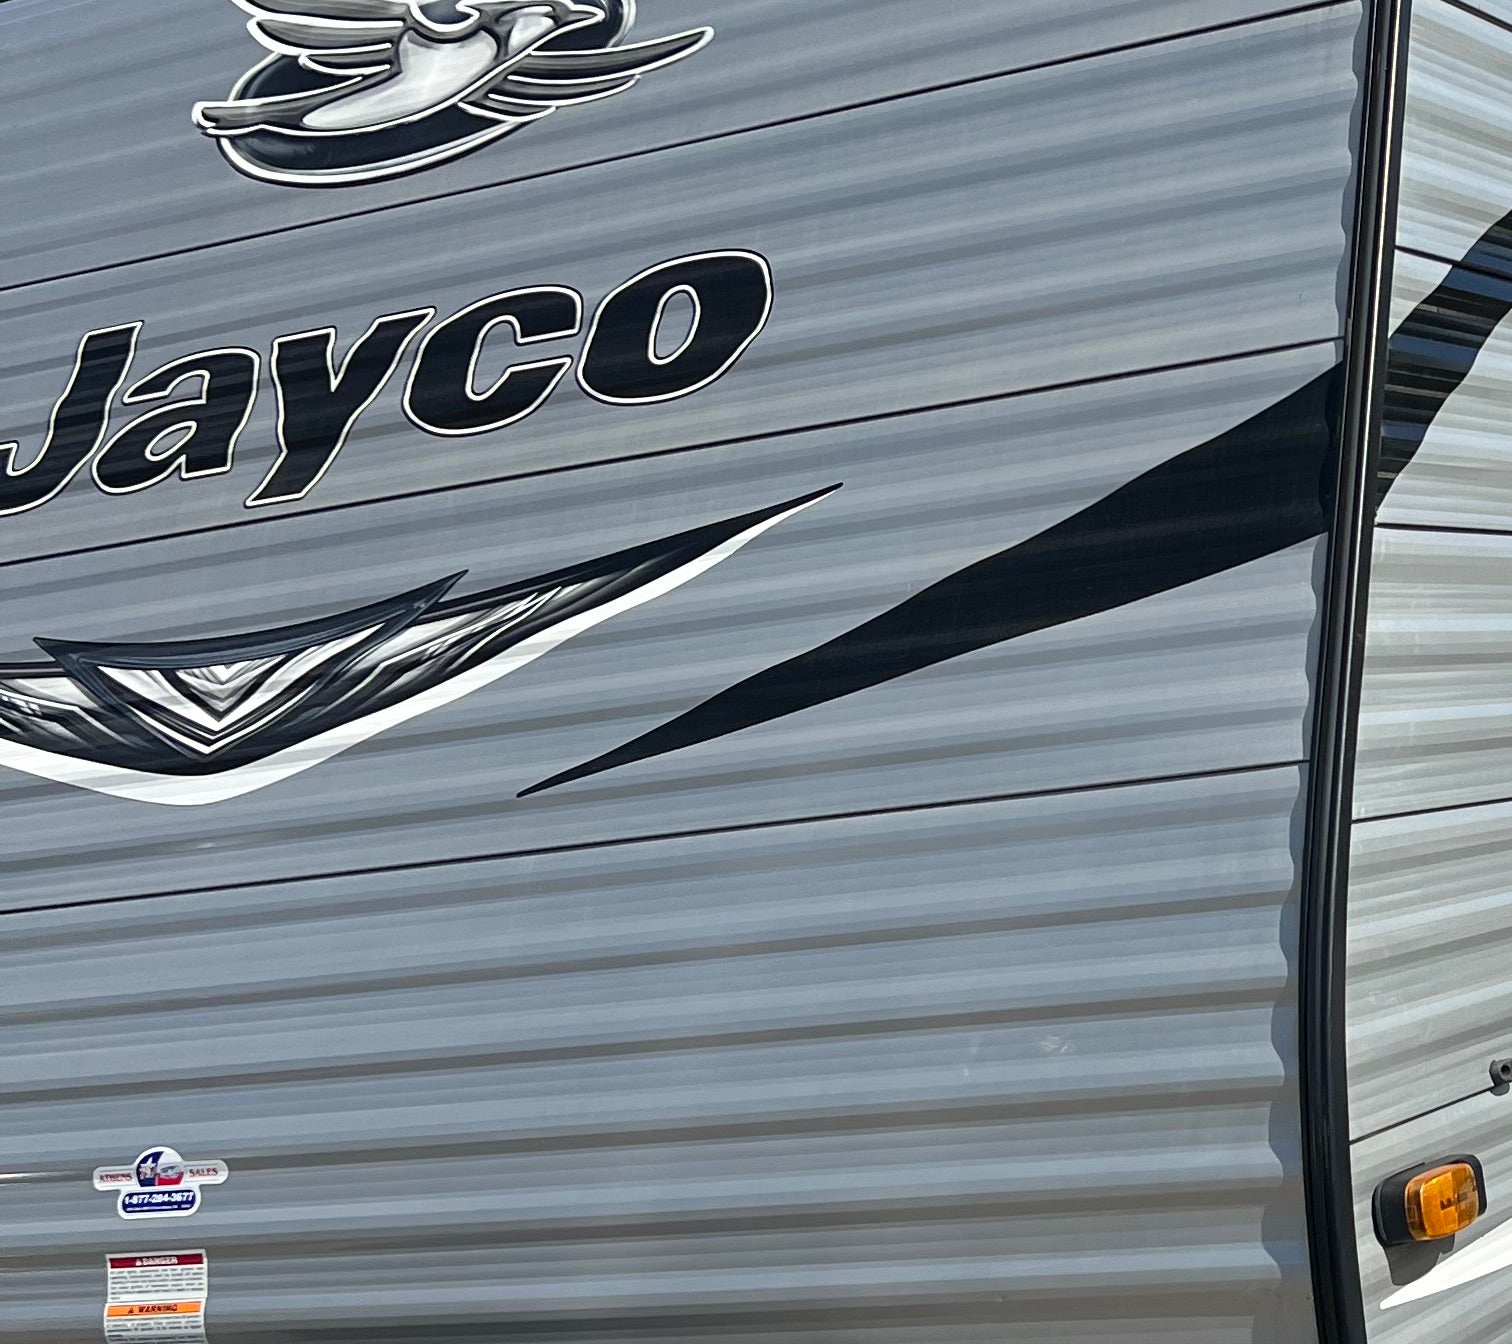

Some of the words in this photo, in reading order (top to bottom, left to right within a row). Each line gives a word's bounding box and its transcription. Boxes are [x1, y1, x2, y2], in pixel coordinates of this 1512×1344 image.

[0, 247, 774, 518] Jayco
[189, 1167, 218, 1177] SALES
[142, 1256, 179, 1266] DANGER
[138, 1304, 178, 1313] WARNING
